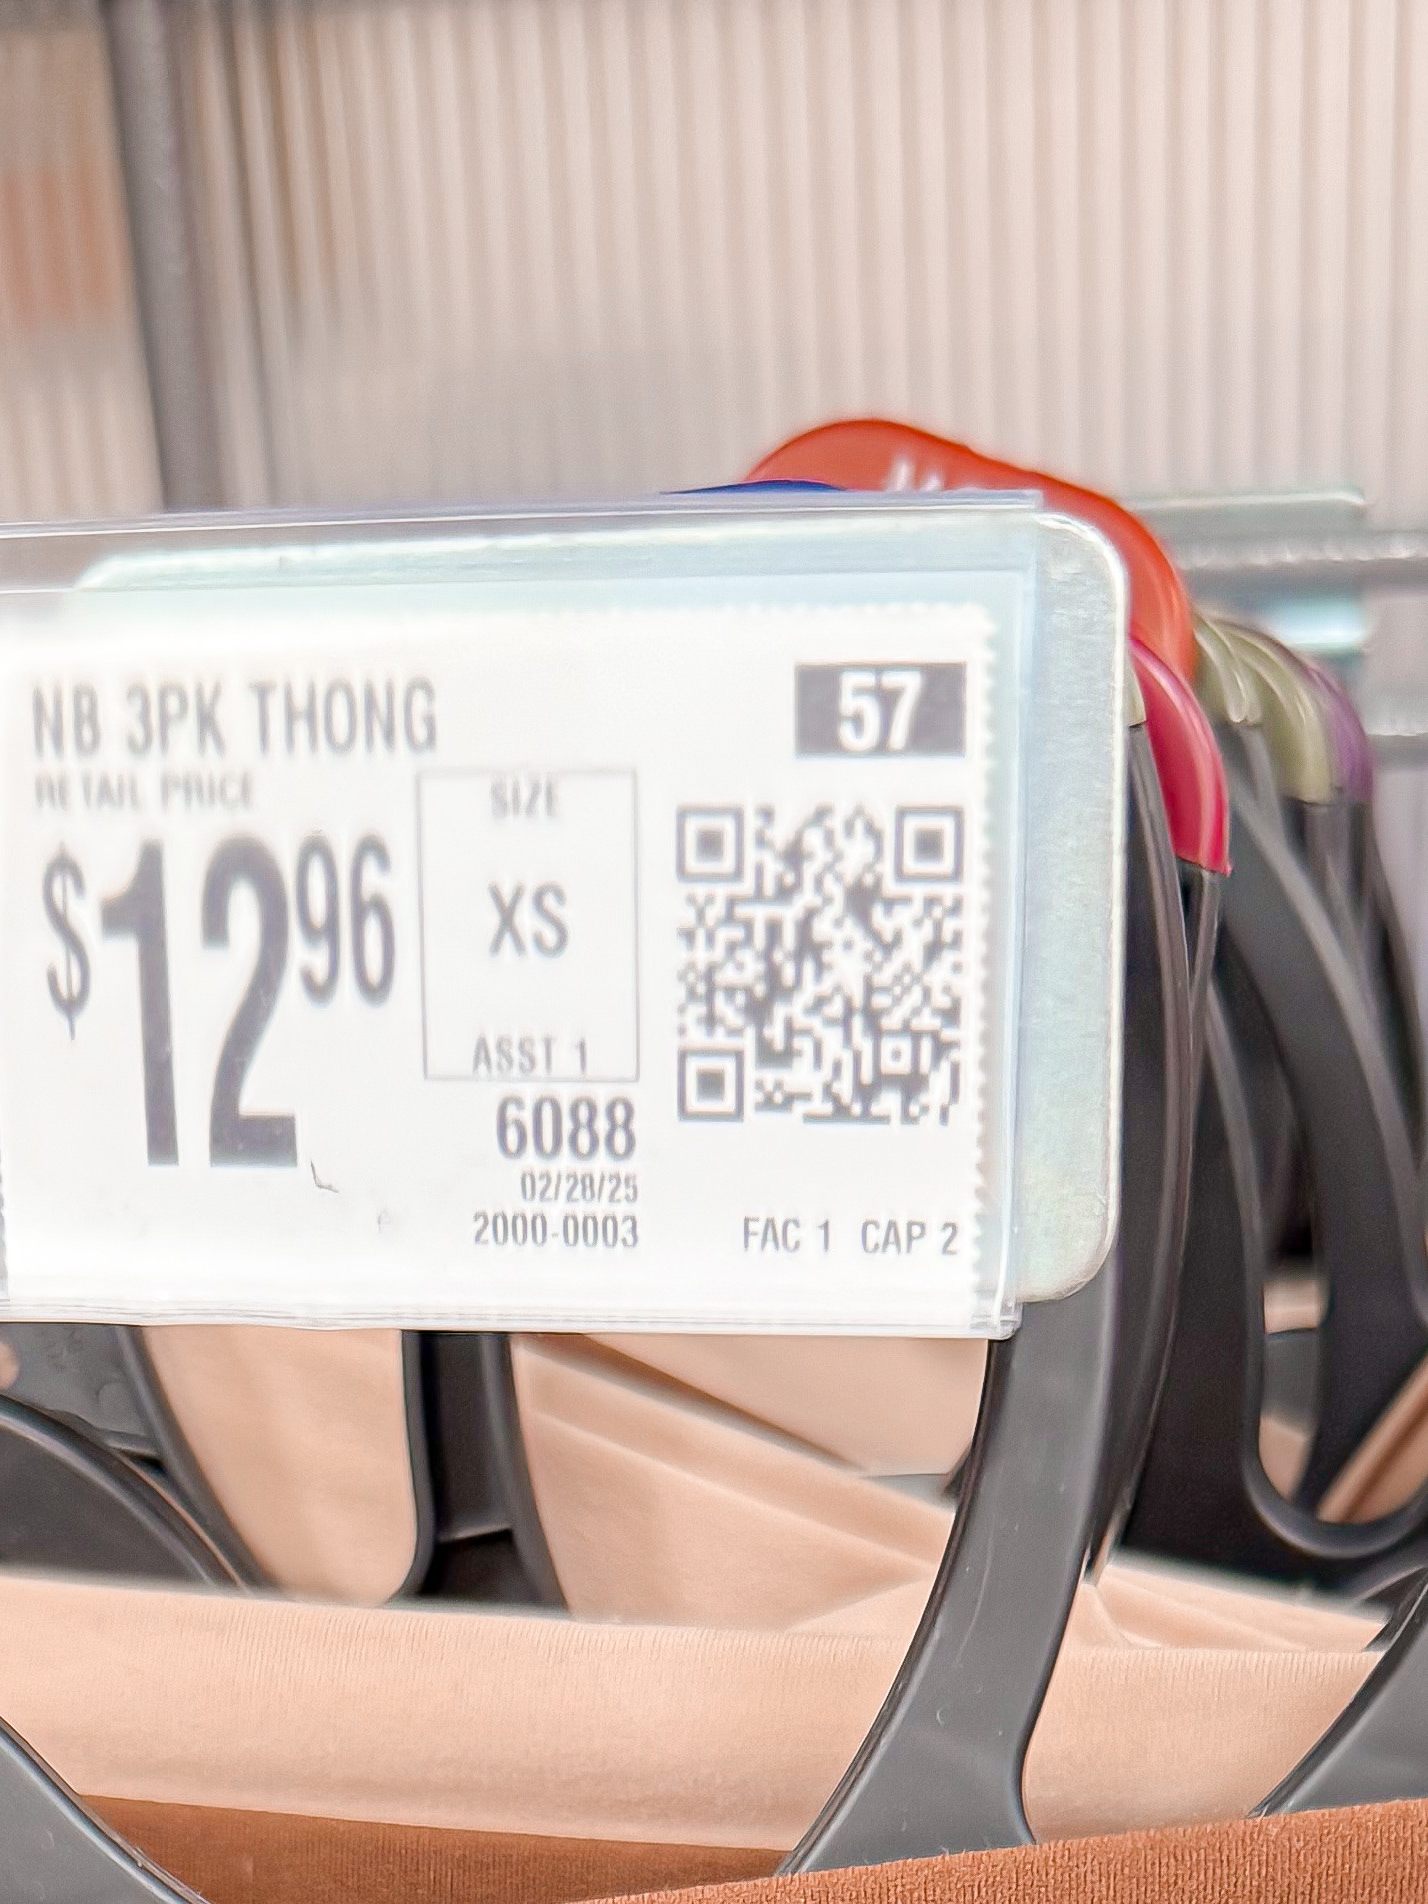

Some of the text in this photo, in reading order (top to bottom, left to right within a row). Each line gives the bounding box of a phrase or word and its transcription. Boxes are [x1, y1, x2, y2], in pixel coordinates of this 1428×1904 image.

[32, 675, 437, 758] NB 3PK THONG
[836, 668, 924, 753] 57
[160, 769, 253, 811] PRICE
[490, 774, 557, 818] SIZE
[487, 881, 569, 959] XS
[473, 1033, 589, 1077] ASST 1
[496, 1095, 637, 1162] 6088
[520, 1170, 639, 1204] 02/28/25
[473, 1210, 639, 1250] 2000-0003
[743, 1215, 960, 1256] FAC 1 CAP 2
